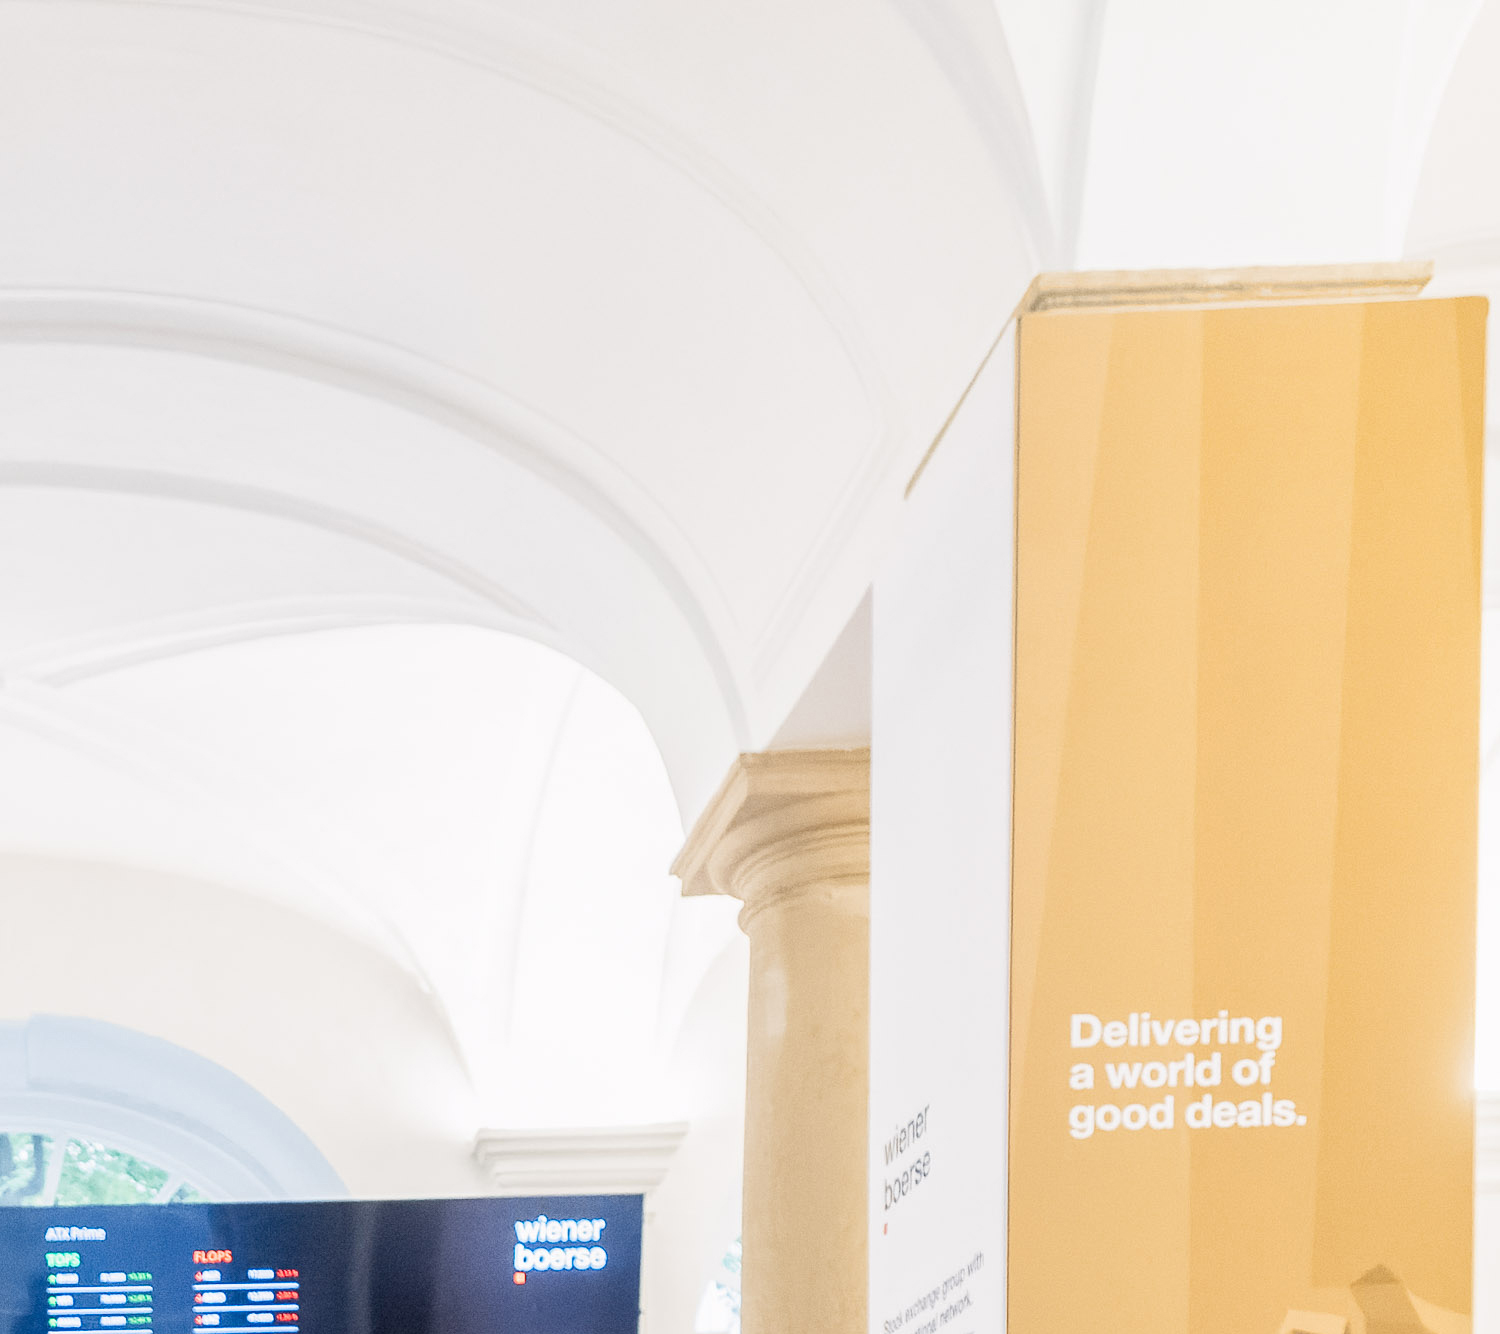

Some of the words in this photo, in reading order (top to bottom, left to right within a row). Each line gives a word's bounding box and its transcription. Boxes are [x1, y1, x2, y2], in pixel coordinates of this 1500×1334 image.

[1070, 1010, 1282, 1051] Delivering
[1069, 1063, 1094, 1090] a
[1105, 1052, 1221, 1089] world
[1231, 1051, 1276, 1085] of
[884, 1104, 930, 1166] wiener
[1069, 1094, 1174, 1139] good
[1185, 1092, 1307, 1128] deals.
[884, 1151, 931, 1211] boerse
[45, 1228, 70, 1241] ATX
[70, 1226, 107, 1241] Prime
[514, 1214, 607, 1243] wiener
[45, 1252, 81, 1267] TOPS
[193, 1249, 233, 1264] FLOPS
[514, 1243, 608, 1272] boerse
[905, 1288, 939, 1321] exchange
[942, 1270, 965, 1299] group
[968, 1252, 984, 1277] with
